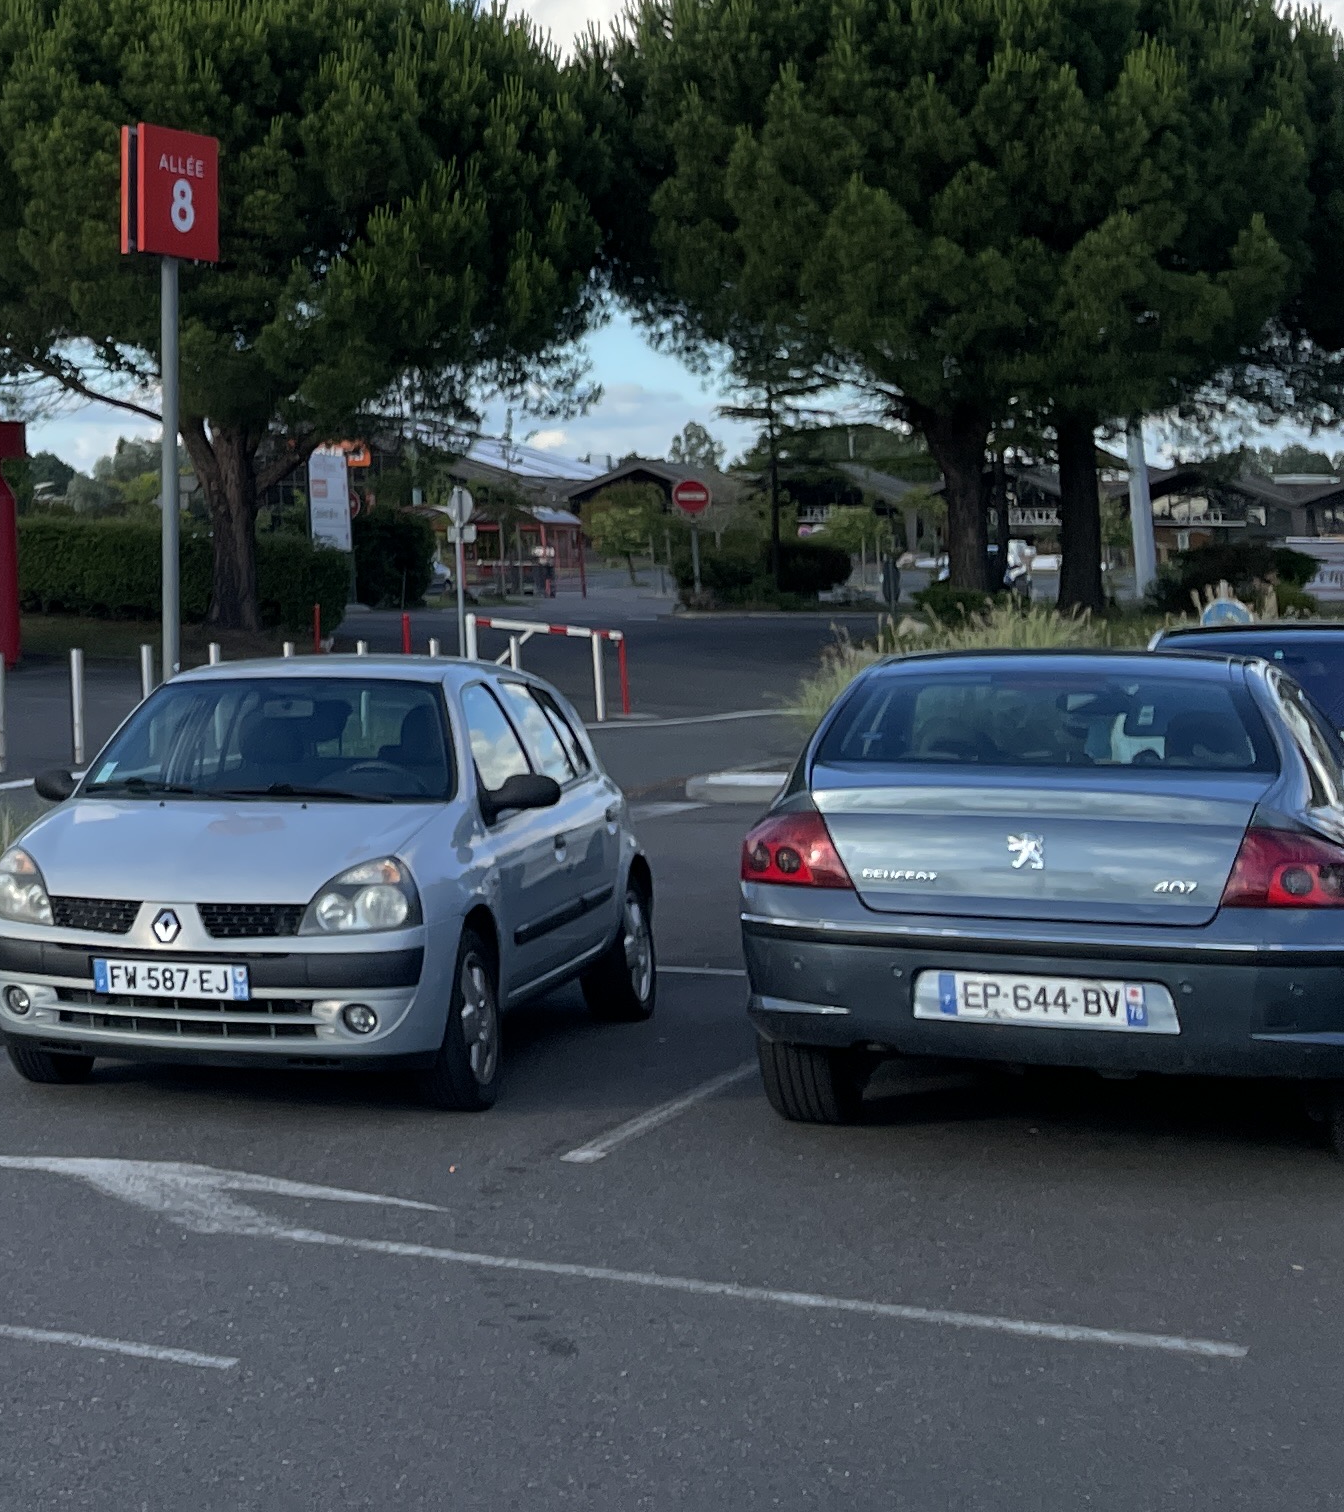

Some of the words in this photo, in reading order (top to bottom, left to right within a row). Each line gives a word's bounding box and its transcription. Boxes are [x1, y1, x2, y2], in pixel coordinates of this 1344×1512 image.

[158, 153, 204, 179] ALLÉE
[170, 178, 195, 233] 8
[1153, 880, 1198, 894] 407
